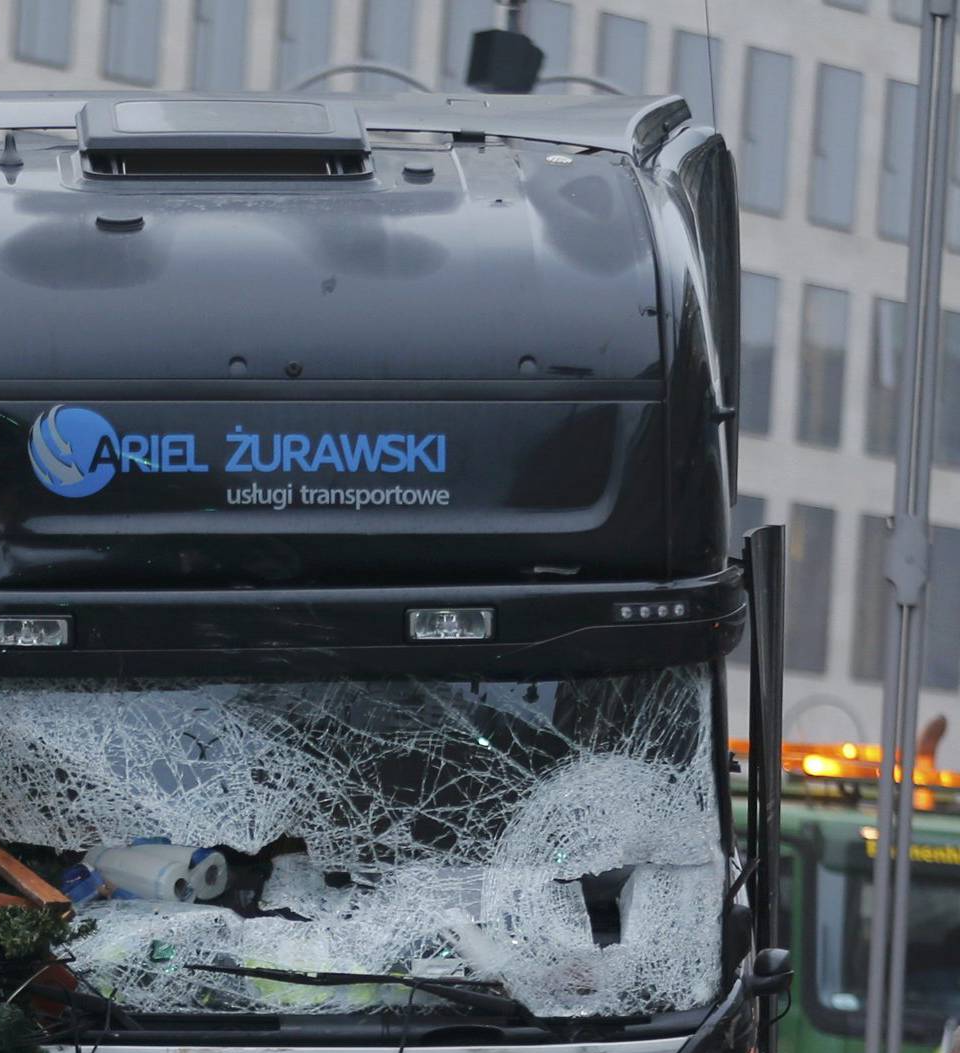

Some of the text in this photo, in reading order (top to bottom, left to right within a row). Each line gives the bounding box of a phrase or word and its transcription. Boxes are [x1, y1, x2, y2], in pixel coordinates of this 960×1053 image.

[88, 425, 446, 473] ARIEL ŻURAWSKI
[227, 483, 450, 510] usługi transportowe
